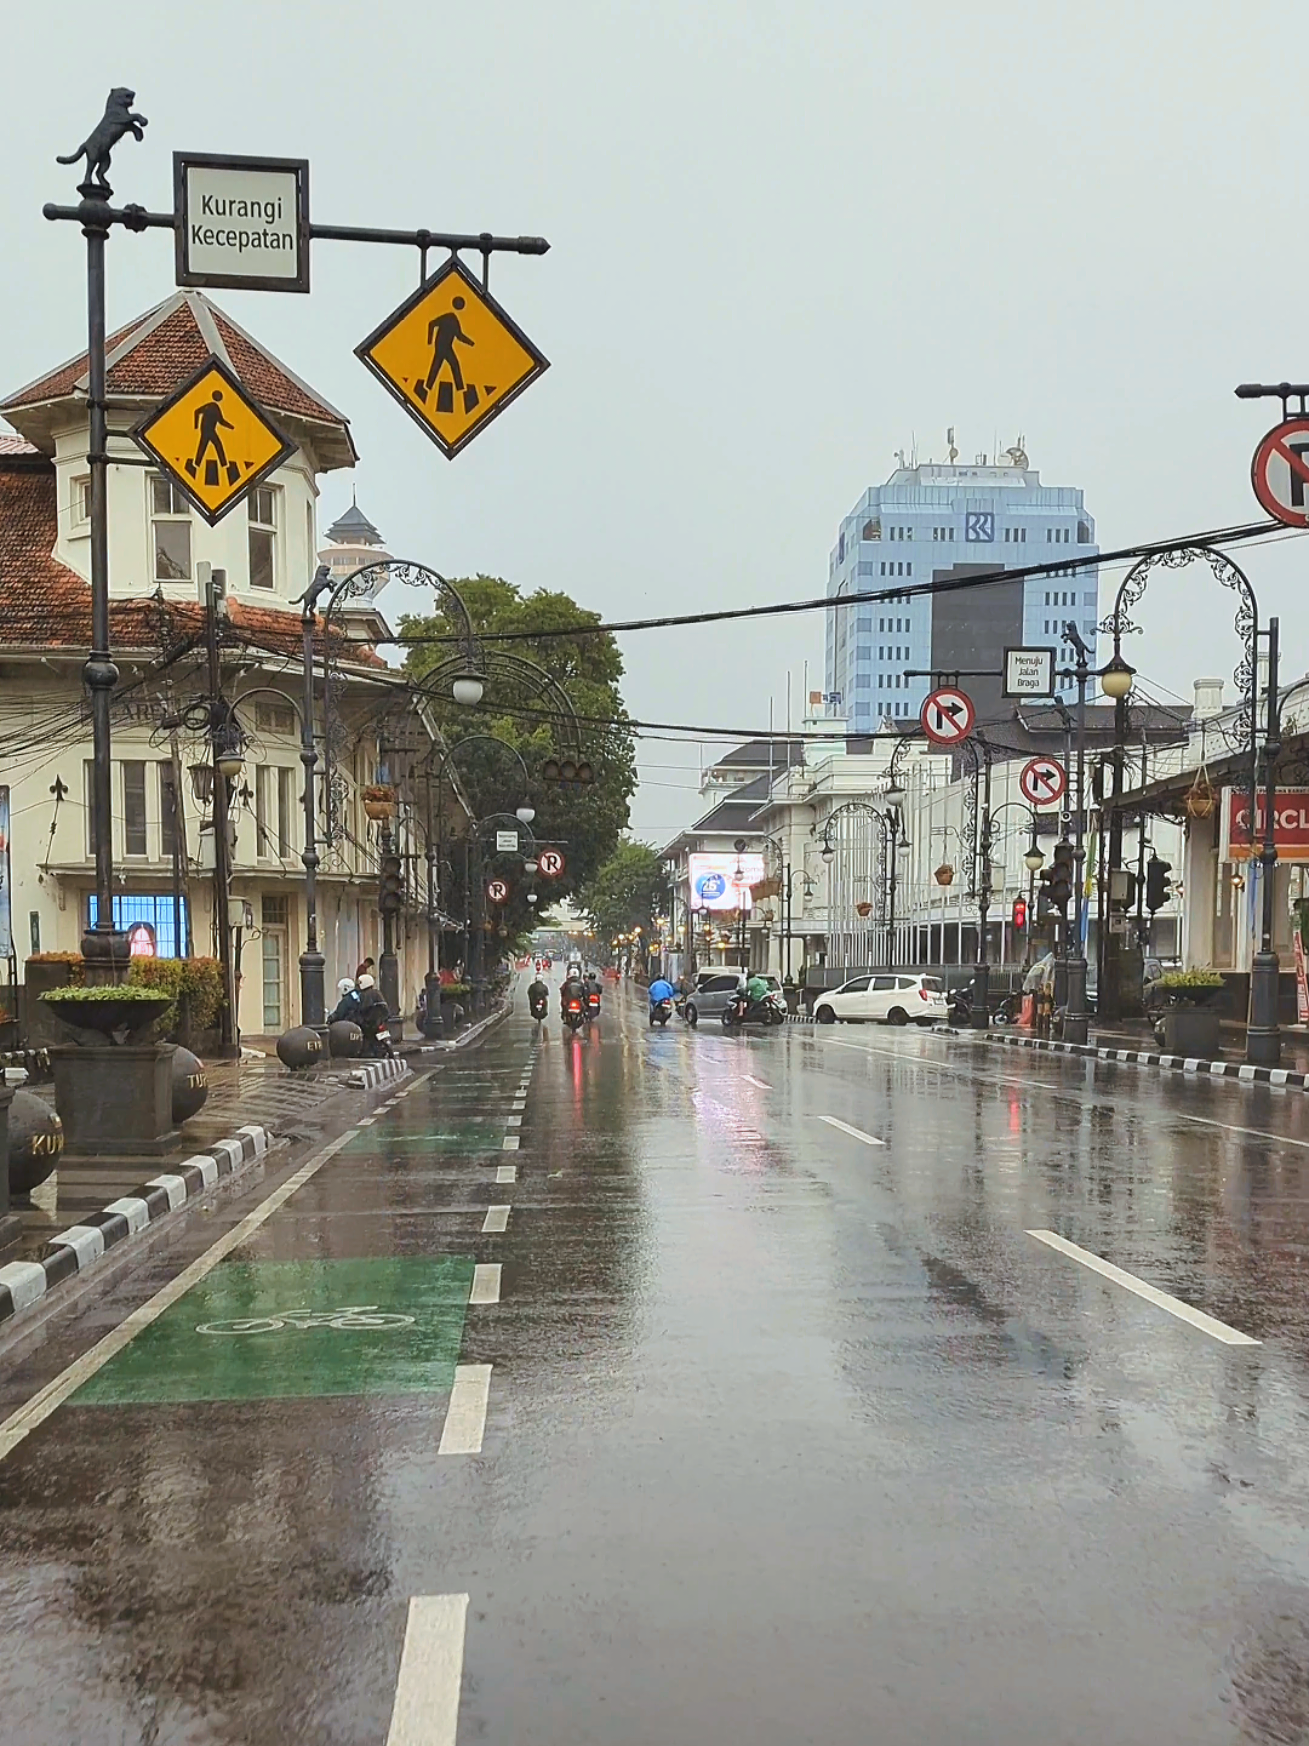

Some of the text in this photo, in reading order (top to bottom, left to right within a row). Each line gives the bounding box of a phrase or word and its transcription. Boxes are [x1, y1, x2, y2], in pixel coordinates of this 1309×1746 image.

[201, 194, 282, 225] Kurangi
[191, 224, 293, 253] Kecepatan
[1015, 656, 1043, 667] Menuju
[1018, 666, 1039, 676] Jalan
[1017, 678, 1040, 689] Braga
